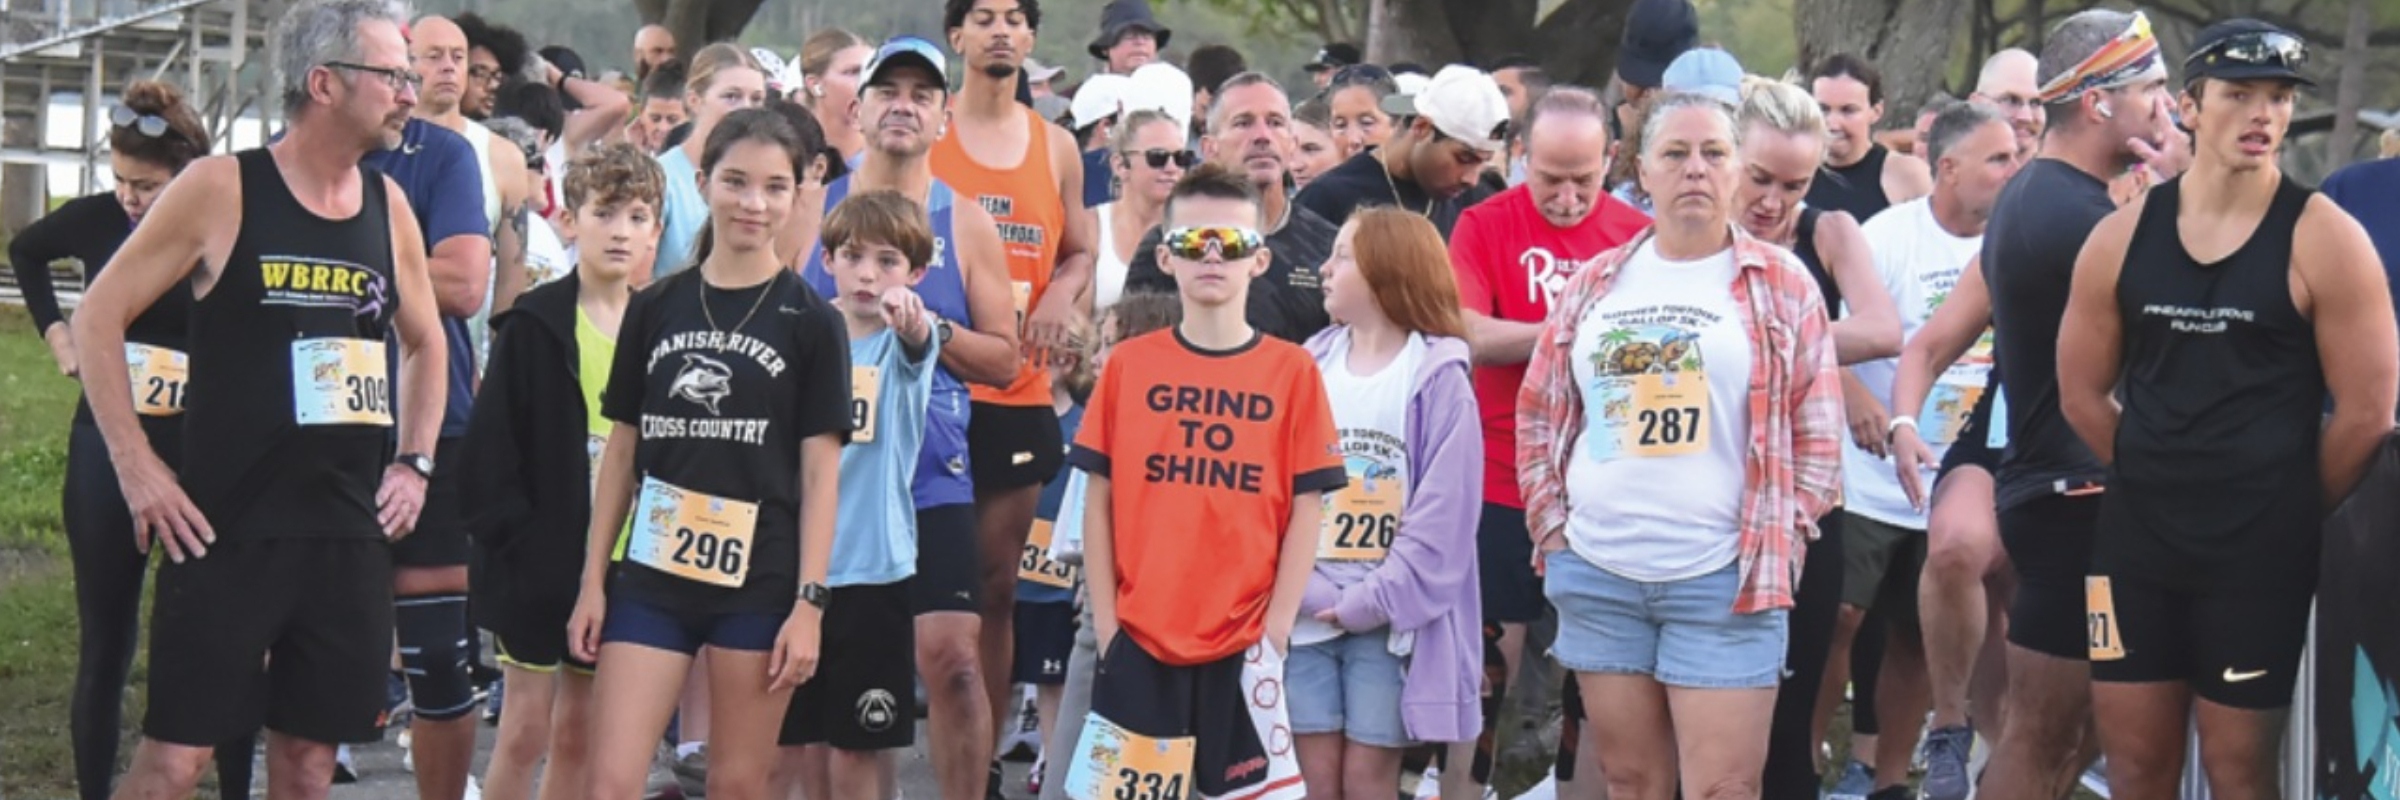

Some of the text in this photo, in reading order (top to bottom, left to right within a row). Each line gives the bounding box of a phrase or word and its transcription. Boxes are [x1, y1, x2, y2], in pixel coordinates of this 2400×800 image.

[979, 195, 1011, 216] TEAM
[261, 263, 368, 296] WBRRC
[1617, 315, 1677, 326] GALLOP
[726, 332, 787, 378] RIVER
[1146, 384, 1274, 422] GRIND
[689, 418, 769, 446] COUNTRY
[1179, 419, 1234, 452] TO
[1638, 408, 1700, 446] 287
[1145, 453, 1263, 494] SHINE
[1335, 512, 1396, 549] 226
[672, 527, 744, 575] 296
[1114, 767, 1184, 800] 334
